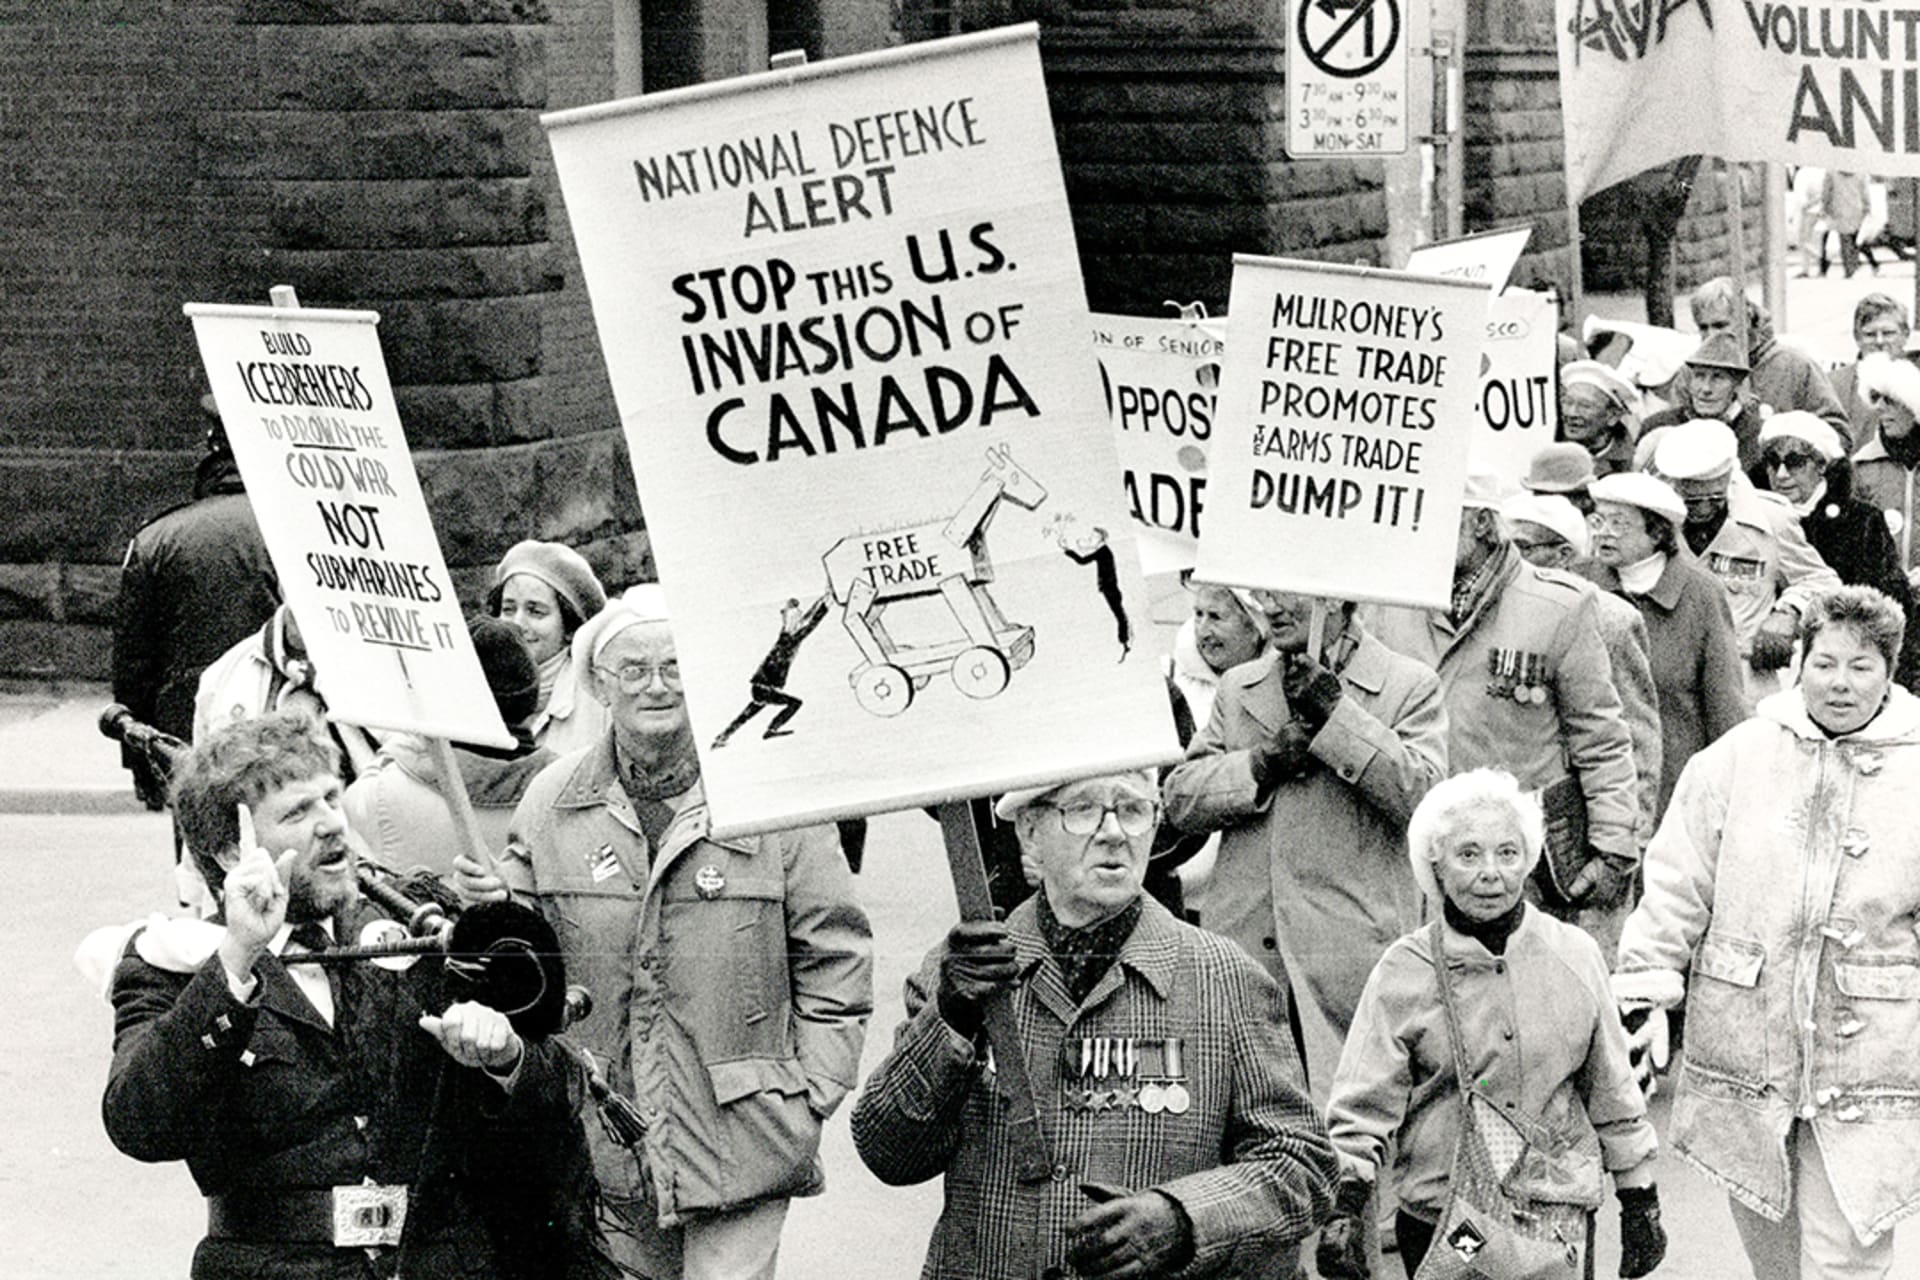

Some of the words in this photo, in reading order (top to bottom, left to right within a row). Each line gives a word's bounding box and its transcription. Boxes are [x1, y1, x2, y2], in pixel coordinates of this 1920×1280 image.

[633, 129, 815, 202] NATIONAL
[829, 97, 986, 169] DEFENCE
[743, 166, 896, 238] ALERT
[671, 258, 797, 323] STOP
[805, 261, 894, 305] THIS
[906, 222, 1018, 283] U.S.
[1123, 336, 1144, 348] OF
[1272, 292, 1443, 342] MULRONEY'S
[260, 330, 312, 356] BUILD
[681, 294, 951, 395] INVASION
[964, 304, 1024, 345] OF
[1266, 336, 1342, 376] FREE
[1356, 346, 1447, 388] TRADE
[236, 360, 373, 411] ICEBREAKERS
[706, 353, 1041, 465] CANADA
[1260, 380, 1437, 430] PROMOTES
[260, 416, 283, 441] TO
[280, 414, 354, 446] DROWN
[350, 425, 388, 448] THE
[1253, 424, 1265, 456] THE
[1264, 426, 1333, 464] ARMS
[1341, 434, 1423, 474] TRADE
[286, 452, 345, 491] COLD
[341, 455, 398, 498] WAR
[316, 500, 385, 551] NOT
[1250, 469, 1363, 519] DUMP
[1373, 483, 1424, 532] IT!
[863, 533, 920, 562] FREE
[863, 555, 942, 588] TRADE
[306, 552, 442, 602] SUBMARINES
[325, 605, 351, 634] TO
[350, 601, 430, 646] REVIVE
[433, 622, 454, 649] IT
